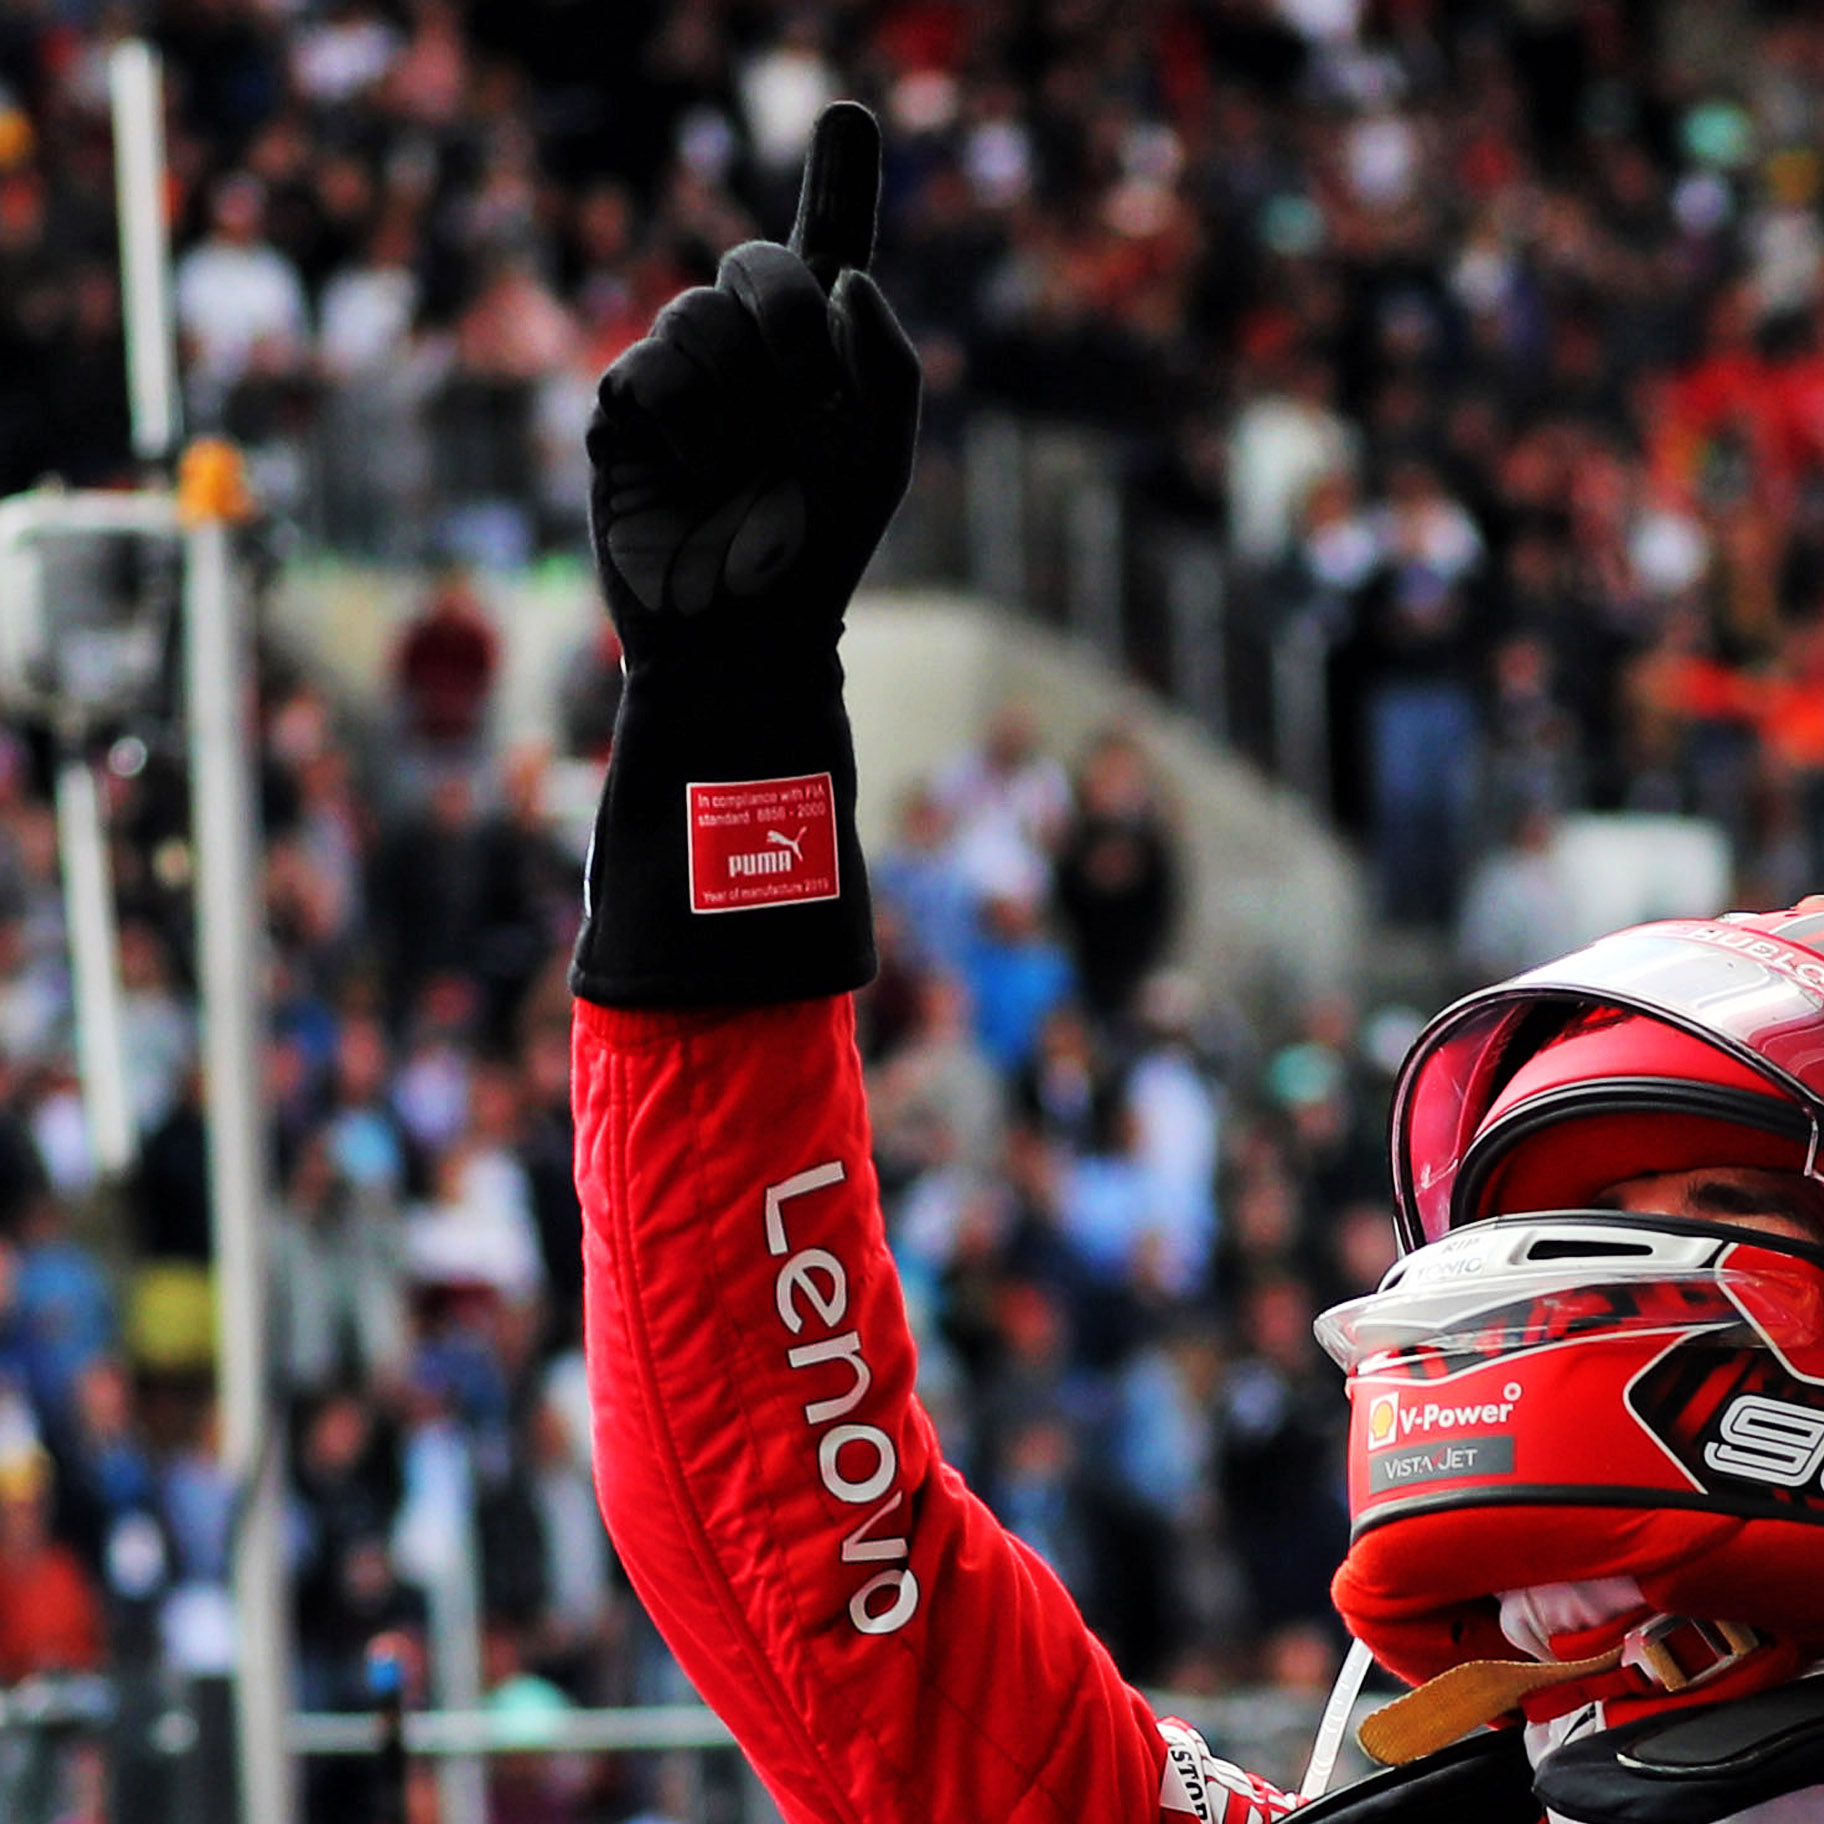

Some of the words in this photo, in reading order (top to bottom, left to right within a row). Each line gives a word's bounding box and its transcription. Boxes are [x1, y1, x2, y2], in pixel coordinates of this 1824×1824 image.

[698, 810, 750, 826] standard
[728, 850, 792, 877] PUMA
[765, 1160, 919, 1635] Lenovo
[1399, 1403, 1514, 1435] V-Power
